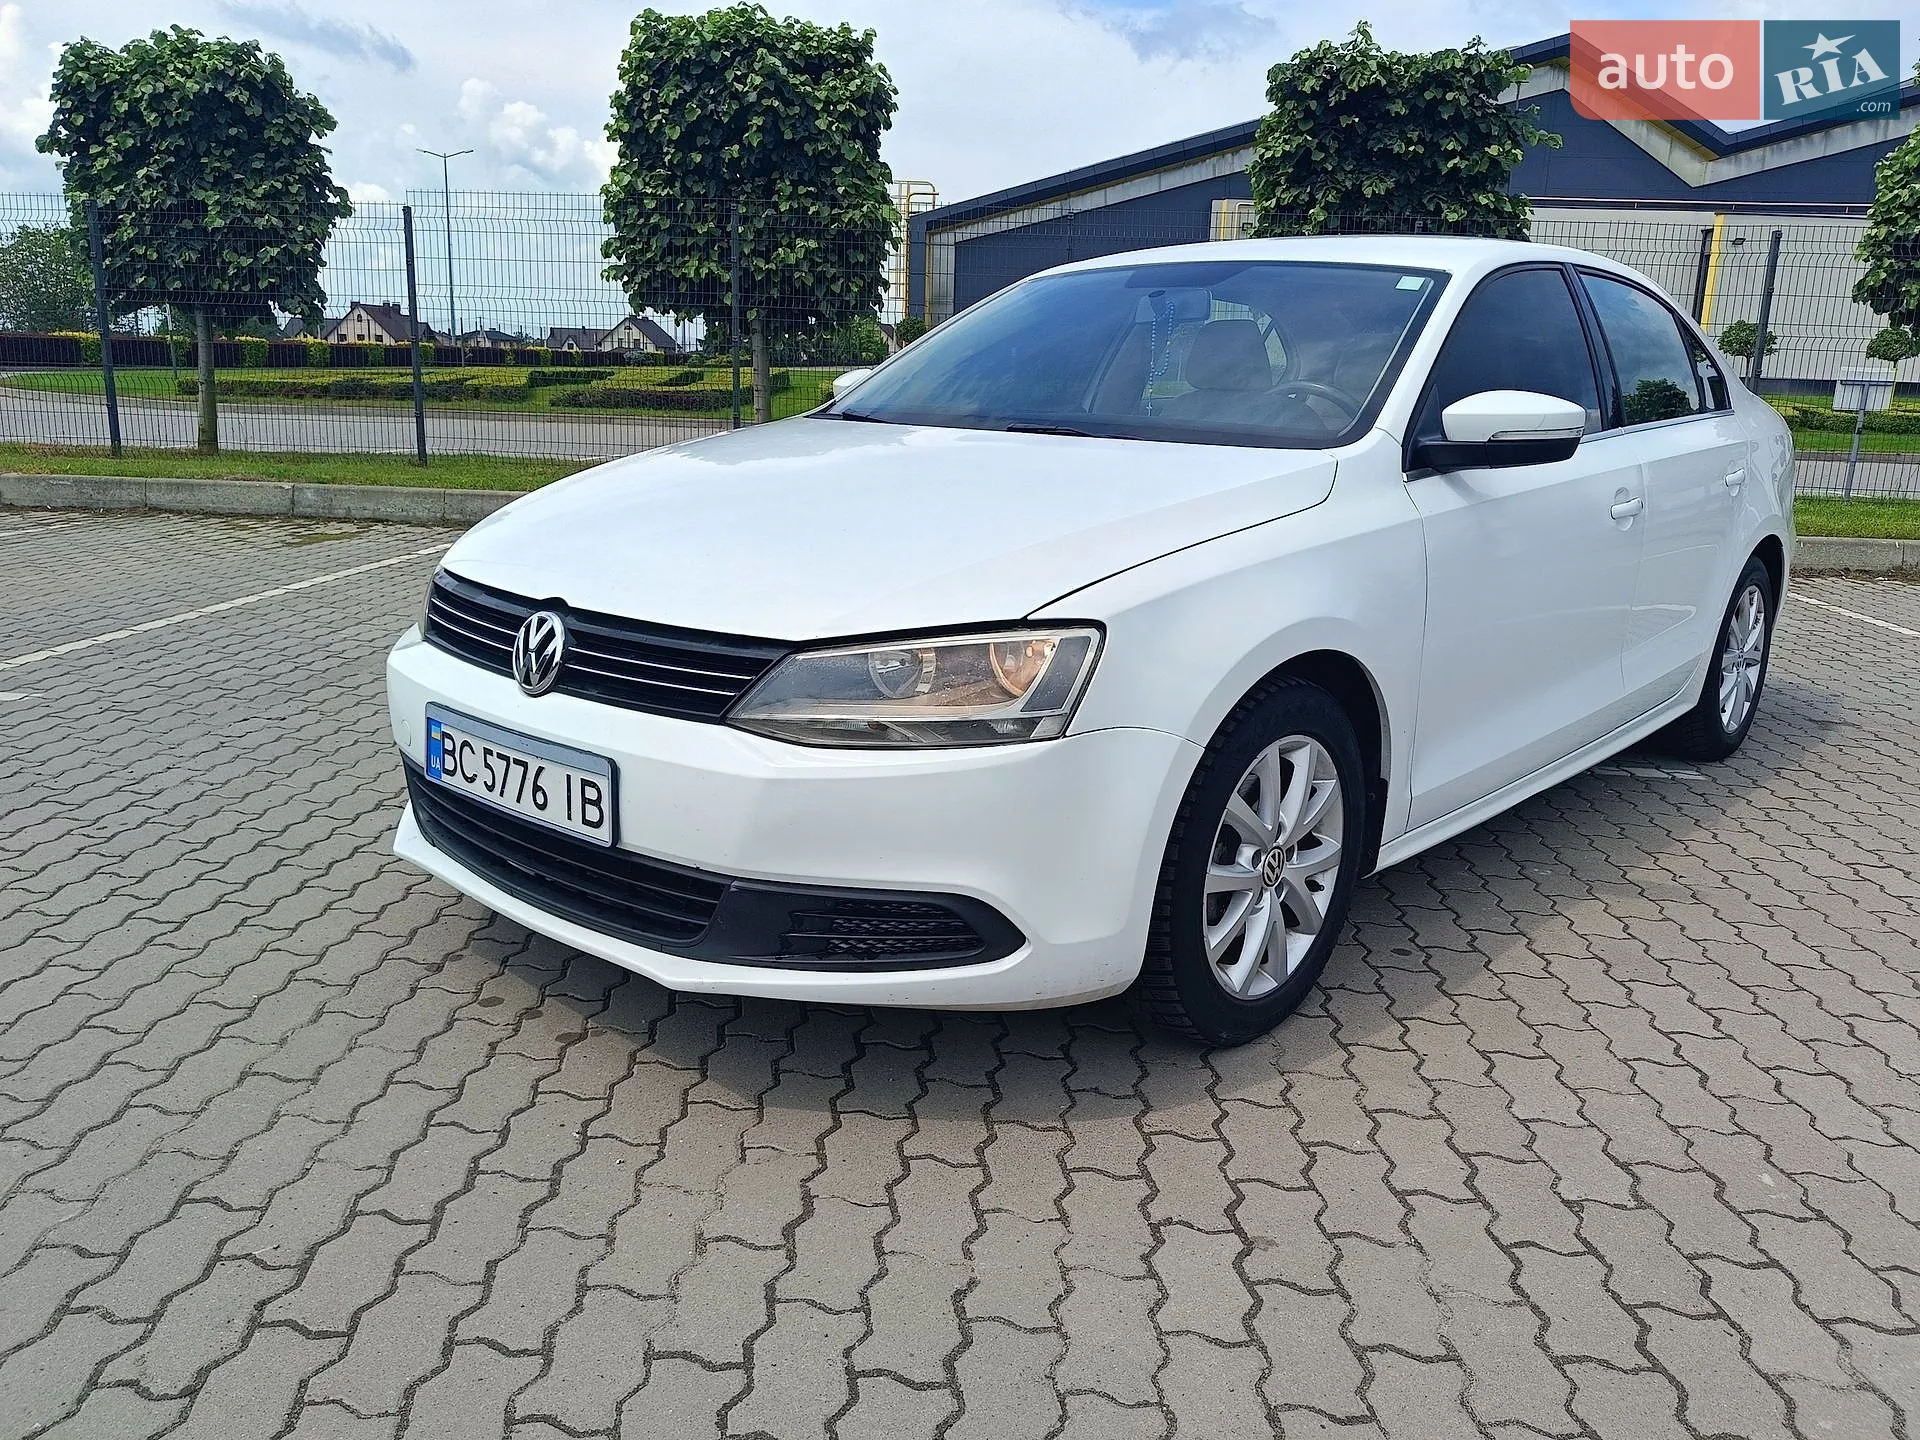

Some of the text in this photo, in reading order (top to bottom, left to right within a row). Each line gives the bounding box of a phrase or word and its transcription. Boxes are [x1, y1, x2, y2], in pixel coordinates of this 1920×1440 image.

[430, 755, 441, 770] UA
[442, 730, 604, 829] BC 5776 IB
